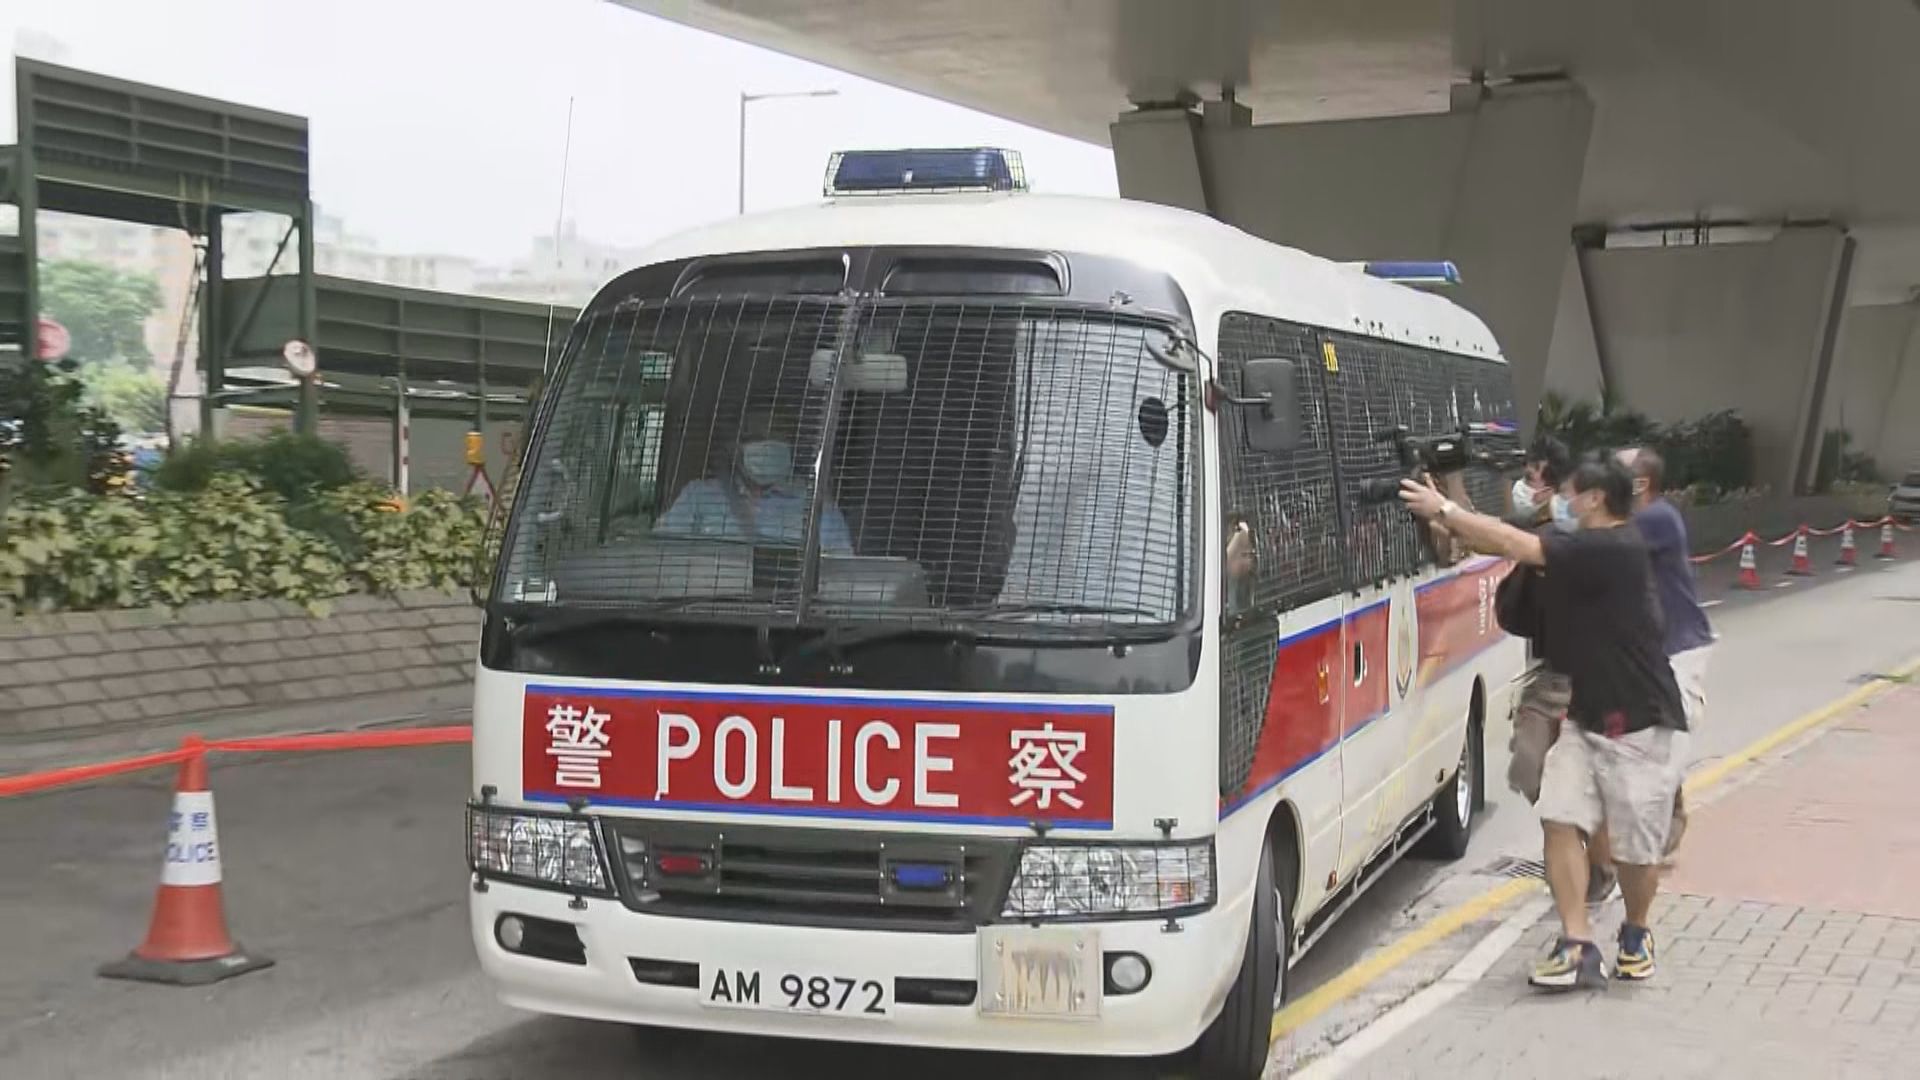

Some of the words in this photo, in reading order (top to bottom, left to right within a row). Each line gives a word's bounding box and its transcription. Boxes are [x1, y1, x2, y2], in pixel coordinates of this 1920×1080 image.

[545, 704, 612, 788] 警
[655, 709, 961, 808] POLICE
[1008, 721, 1088, 810] 察
[710, 967, 761, 1005] AM
[780, 973, 886, 1015] 9872
